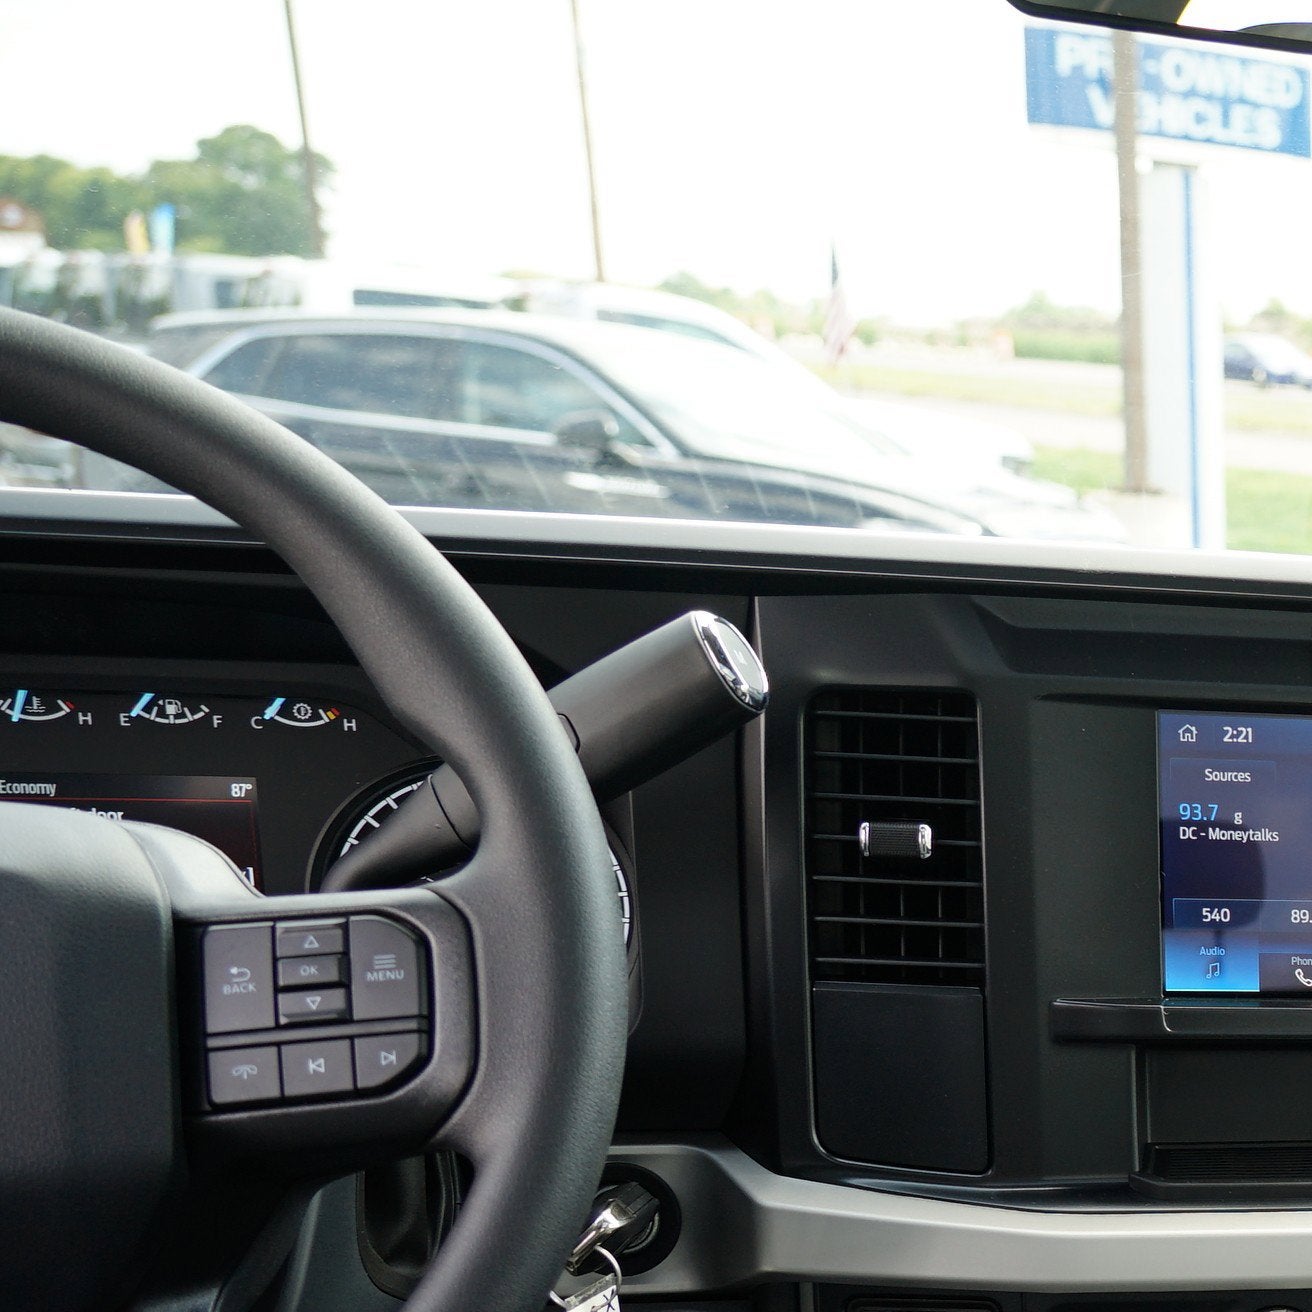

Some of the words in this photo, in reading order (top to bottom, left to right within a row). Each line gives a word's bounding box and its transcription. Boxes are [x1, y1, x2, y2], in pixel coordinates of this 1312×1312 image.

[1055, 32, 1303, 109] PR-OWNED
[1085, 82, 1283, 150] VHICLES
[78, 712, 93, 726] H
[119, 713, 131, 726] E
[212, 715, 223, 728] F
[250, 716, 264, 729] C
[343, 718, 357, 732] H
[1222, 727, 1253, 743] 2:21
[1204, 768, 1251, 783] Sources
[0, 780, 57, 797] Economy
[230, 783, 253, 798] 87°
[1178, 803, 1219, 821] 93.7
[1233, 812, 1243, 825] g
[1179, 826, 1198, 840] DC
[1208, 827, 1280, 844] Moneytalks
[1202, 907, 1231, 923] 540
[1199, 946, 1226, 956] Audio
[299, 965, 319, 976] OK
[366, 969, 405, 982] MENU
[222, 982, 257, 995] BACK
